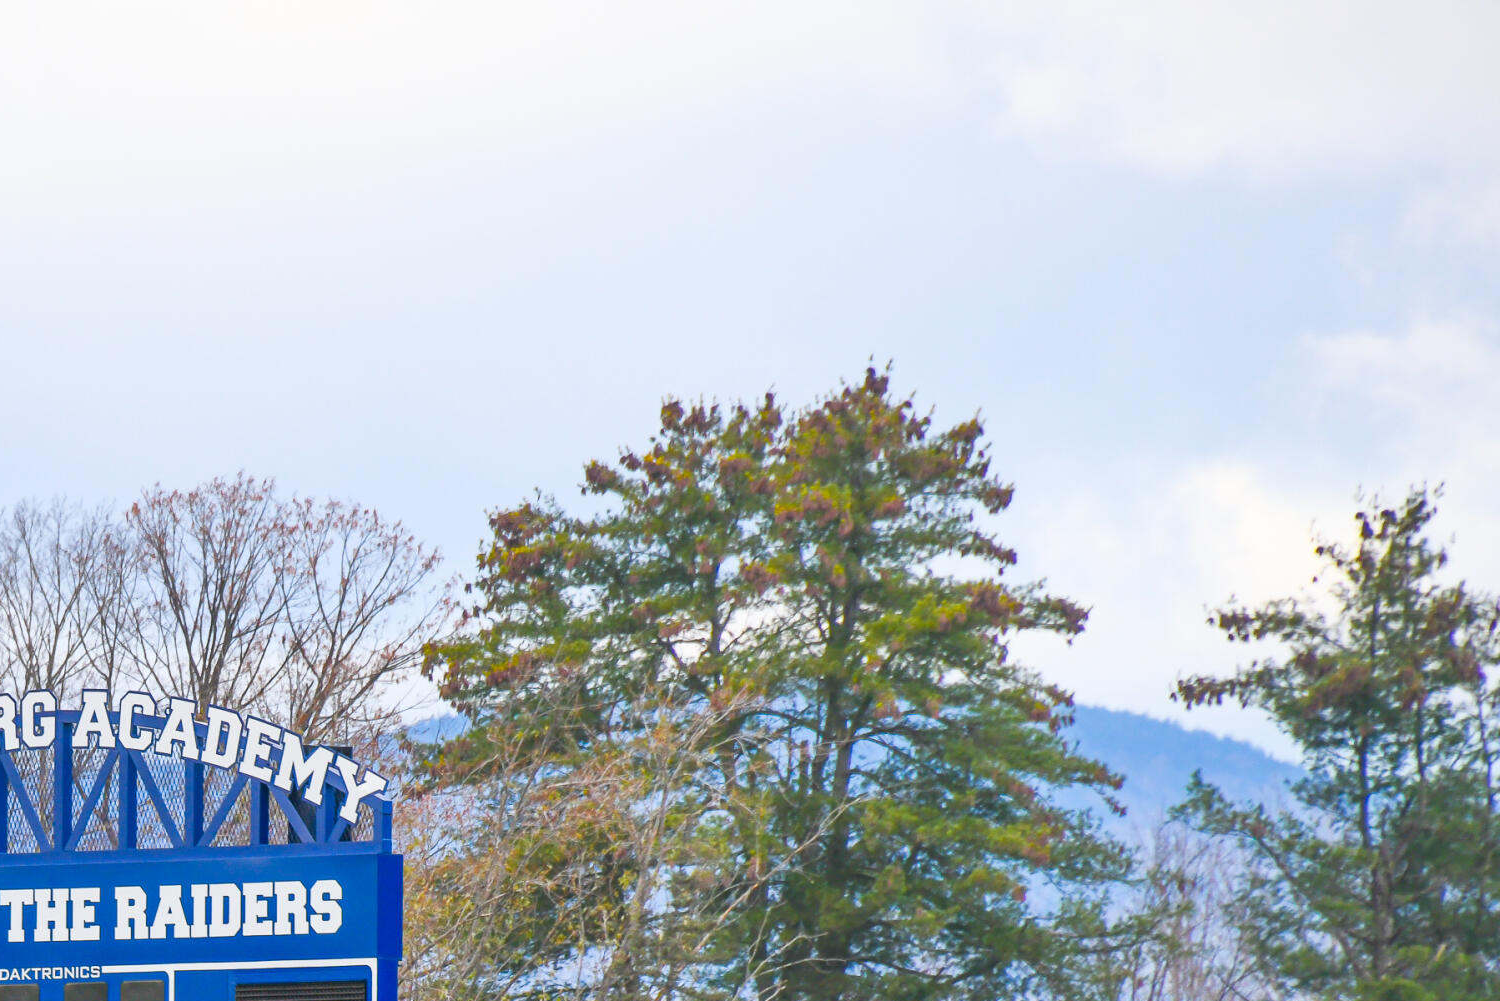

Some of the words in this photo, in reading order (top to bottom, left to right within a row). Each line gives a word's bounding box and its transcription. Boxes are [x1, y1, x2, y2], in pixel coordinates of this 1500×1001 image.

[72, 689, 388, 824] ACADEMY
[0, 887, 101, 943] THE
[114, 879, 343, 940] RAIDERS
